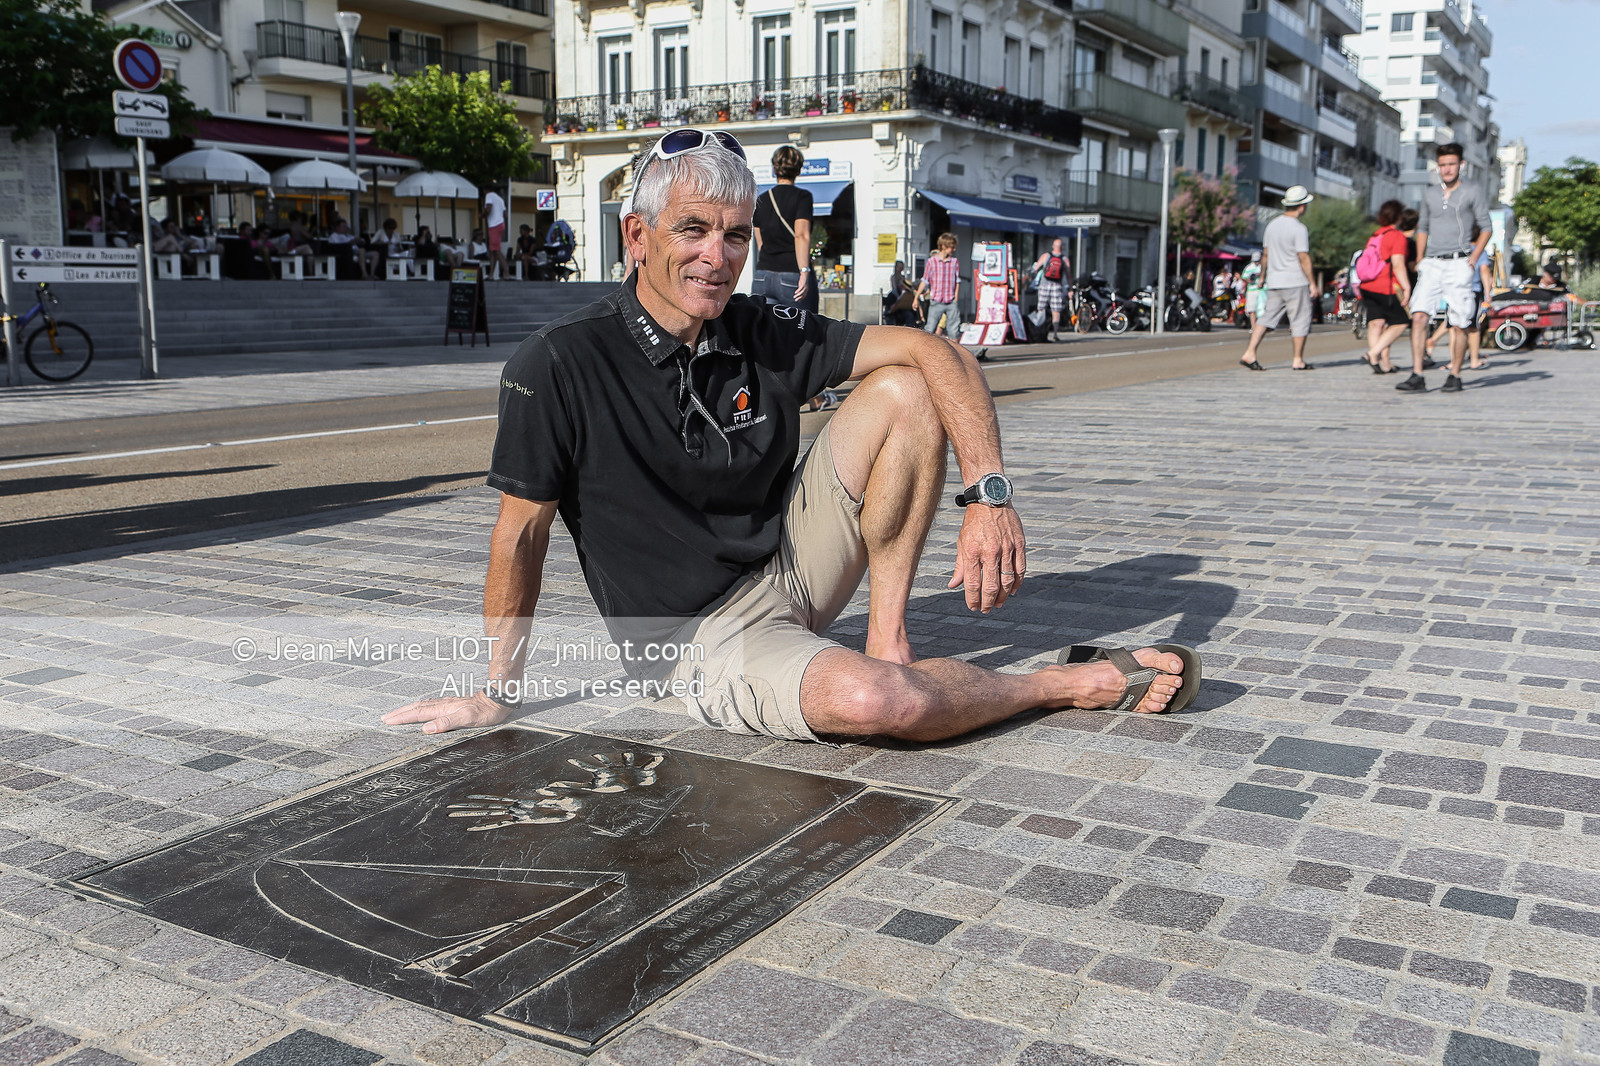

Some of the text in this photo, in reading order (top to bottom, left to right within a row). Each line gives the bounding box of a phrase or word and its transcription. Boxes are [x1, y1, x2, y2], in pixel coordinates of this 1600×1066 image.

[55, 248, 137, 261] Office de Tourisme
[75, 270, 137, 280] Les ATLANTES
[636, 315, 660, 346] PRB
[247, 794, 353, 832] SABLES
[195, 833, 290, 869] VILLE
[287, 815, 337, 834] DU
[656, 886, 734, 930] VINCENT
[729, 866, 768, 887] RIOU
[698, 889, 765, 927] EDITION
[661, 914, 762, 975] VAINQUEUR
